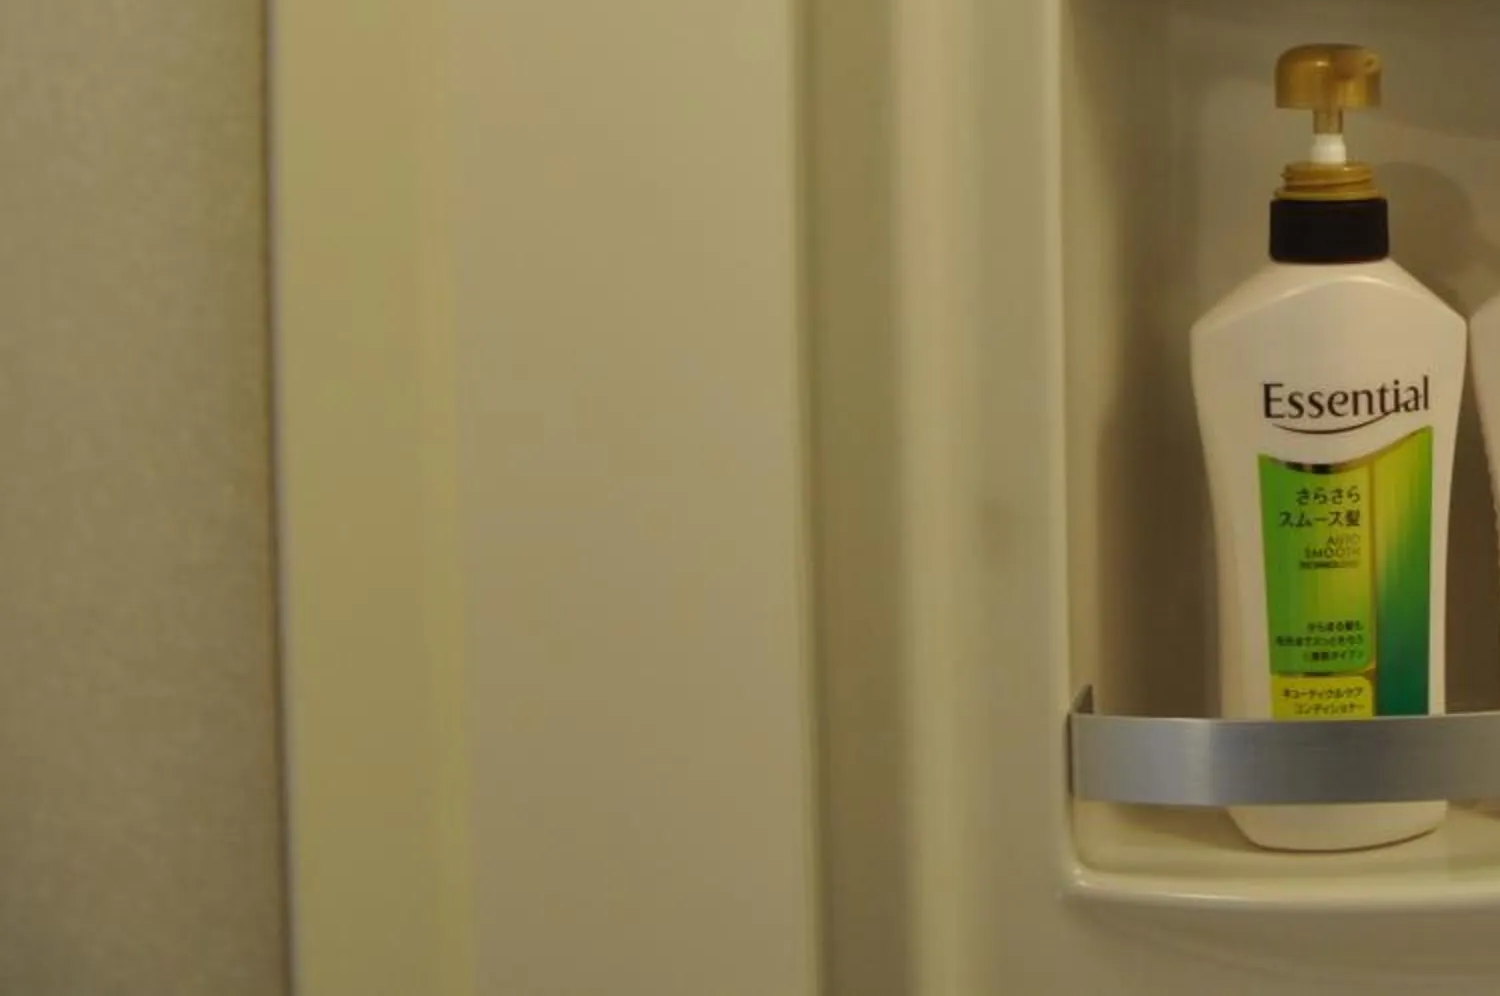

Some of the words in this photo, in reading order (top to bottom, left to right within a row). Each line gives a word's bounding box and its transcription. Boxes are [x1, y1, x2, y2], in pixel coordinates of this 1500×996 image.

[1263, 376, 1430, 420] Essential
[1295, 486, 1361, 506] さらさら
[1279, 510, 1361, 529] スムース髪
